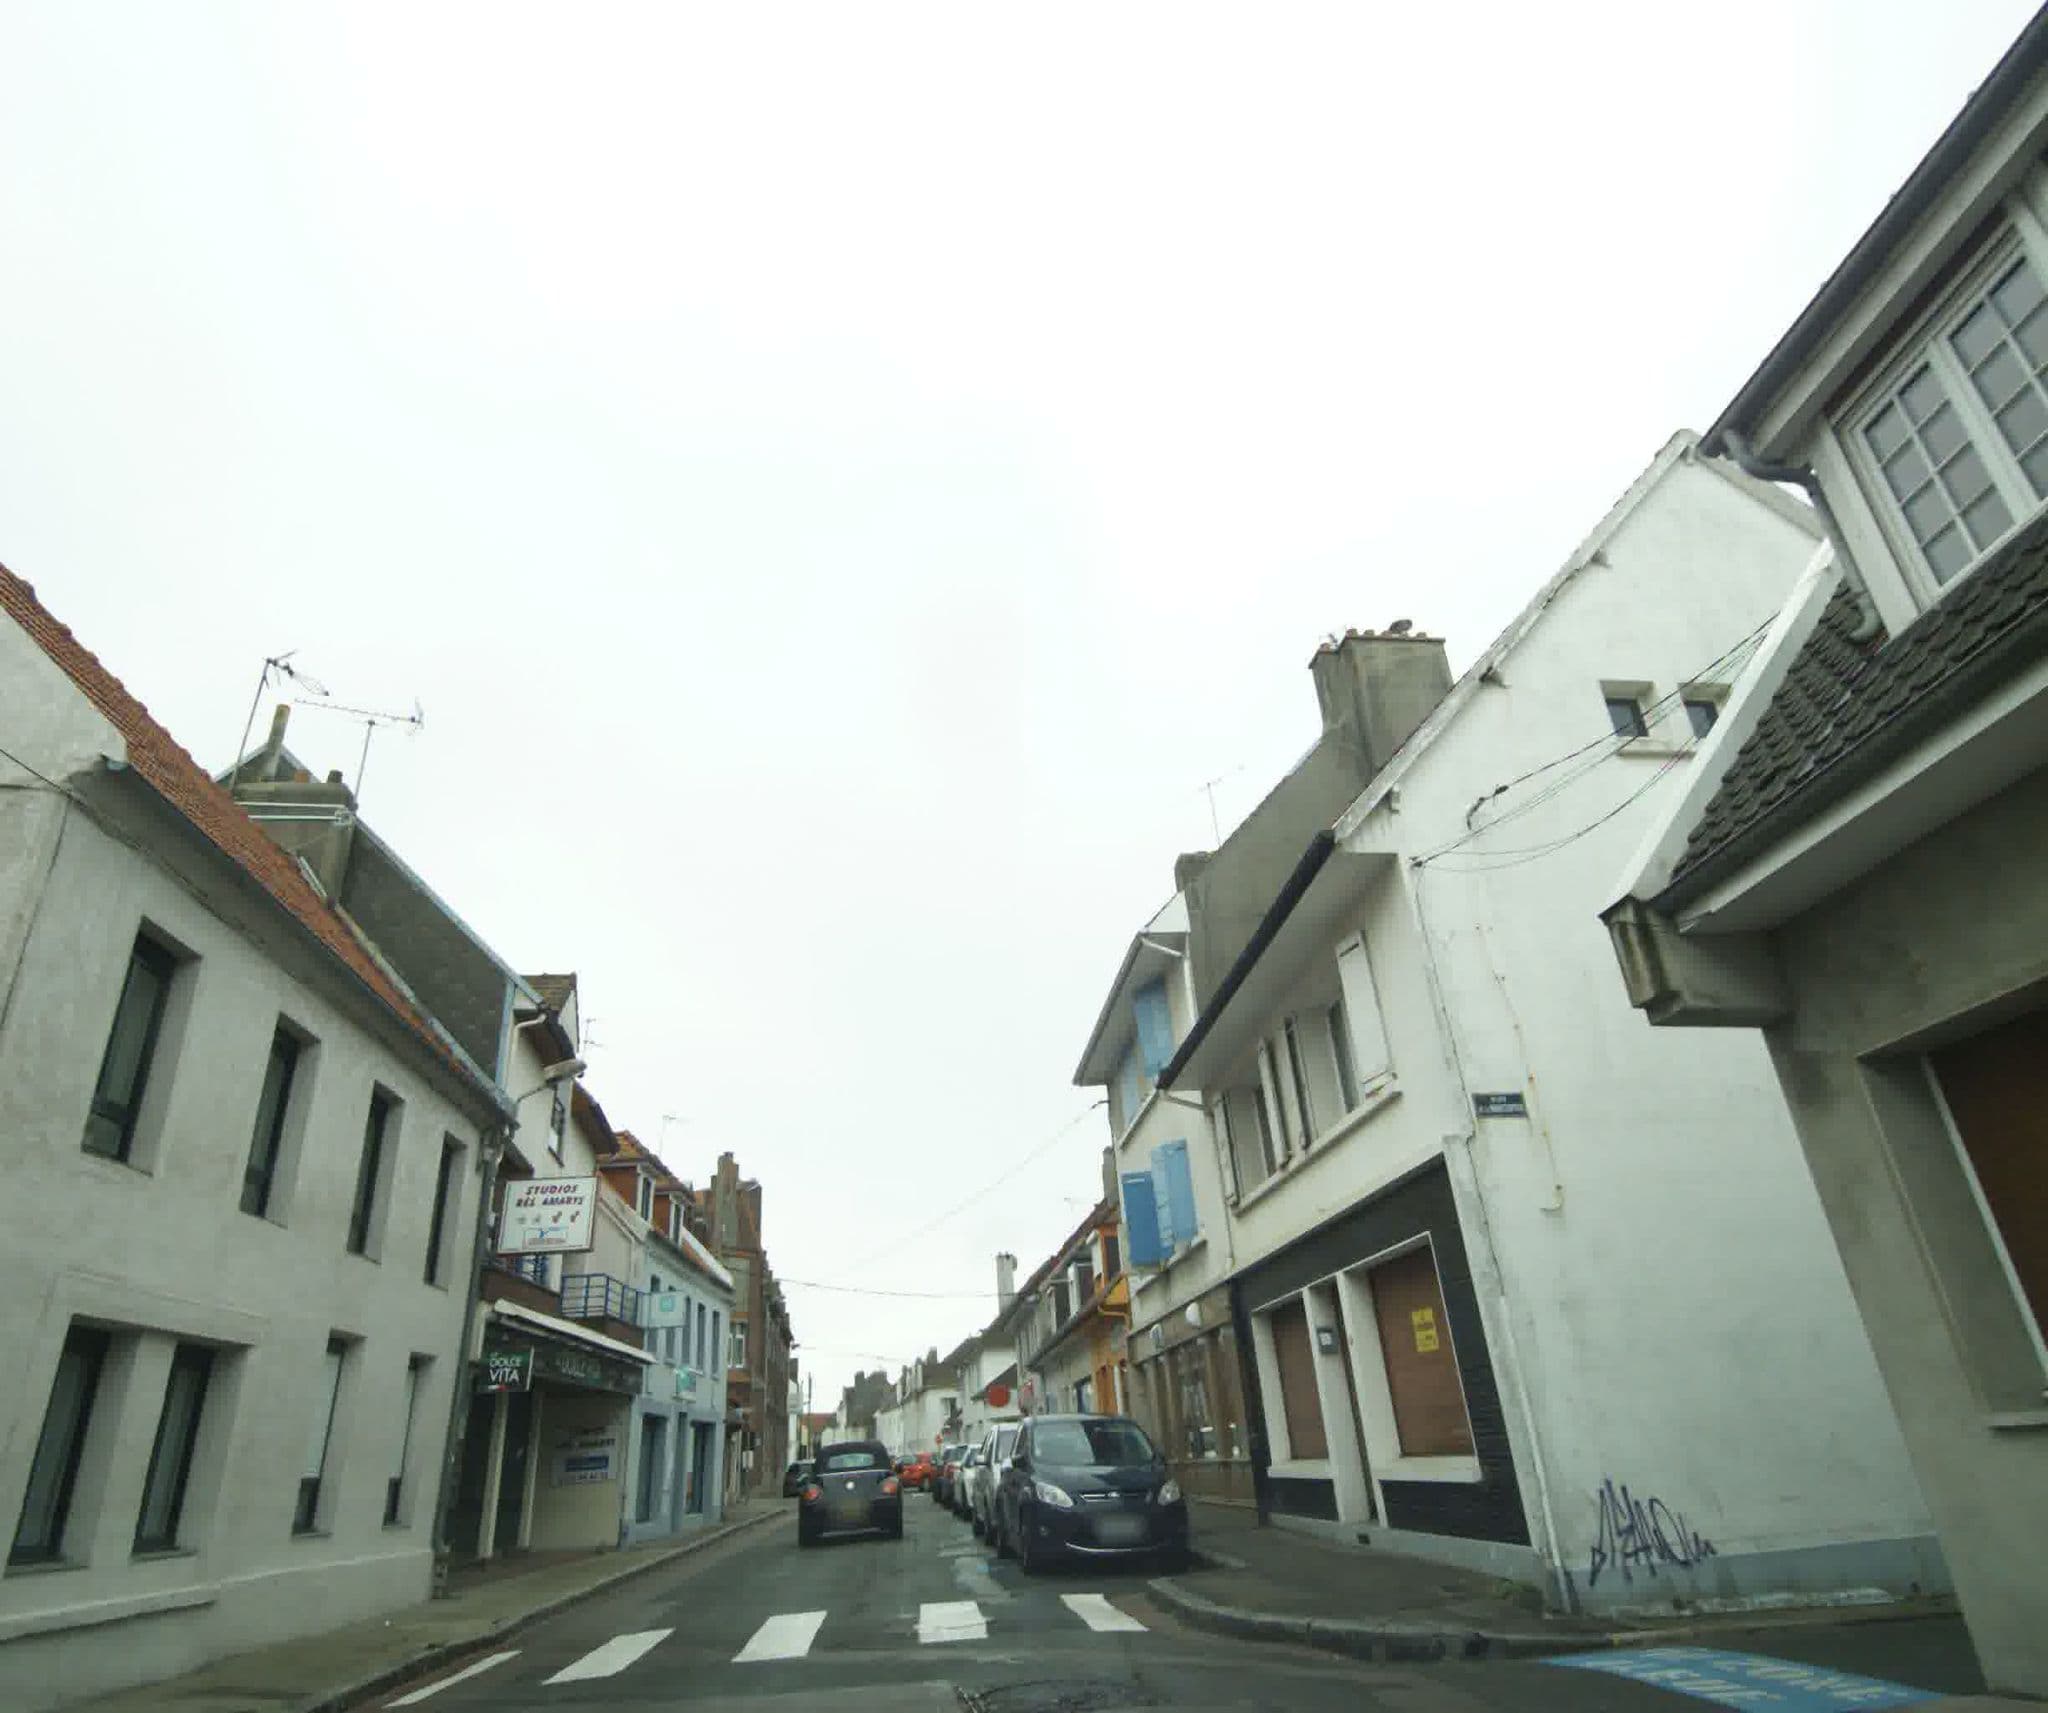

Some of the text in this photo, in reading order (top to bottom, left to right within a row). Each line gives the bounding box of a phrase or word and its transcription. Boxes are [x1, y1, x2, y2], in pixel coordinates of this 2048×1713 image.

[525, 1184, 578, 1195] STUDIOS
[489, 1356, 523, 1368] DOLCE
[489, 1367, 520, 1383] VITA
